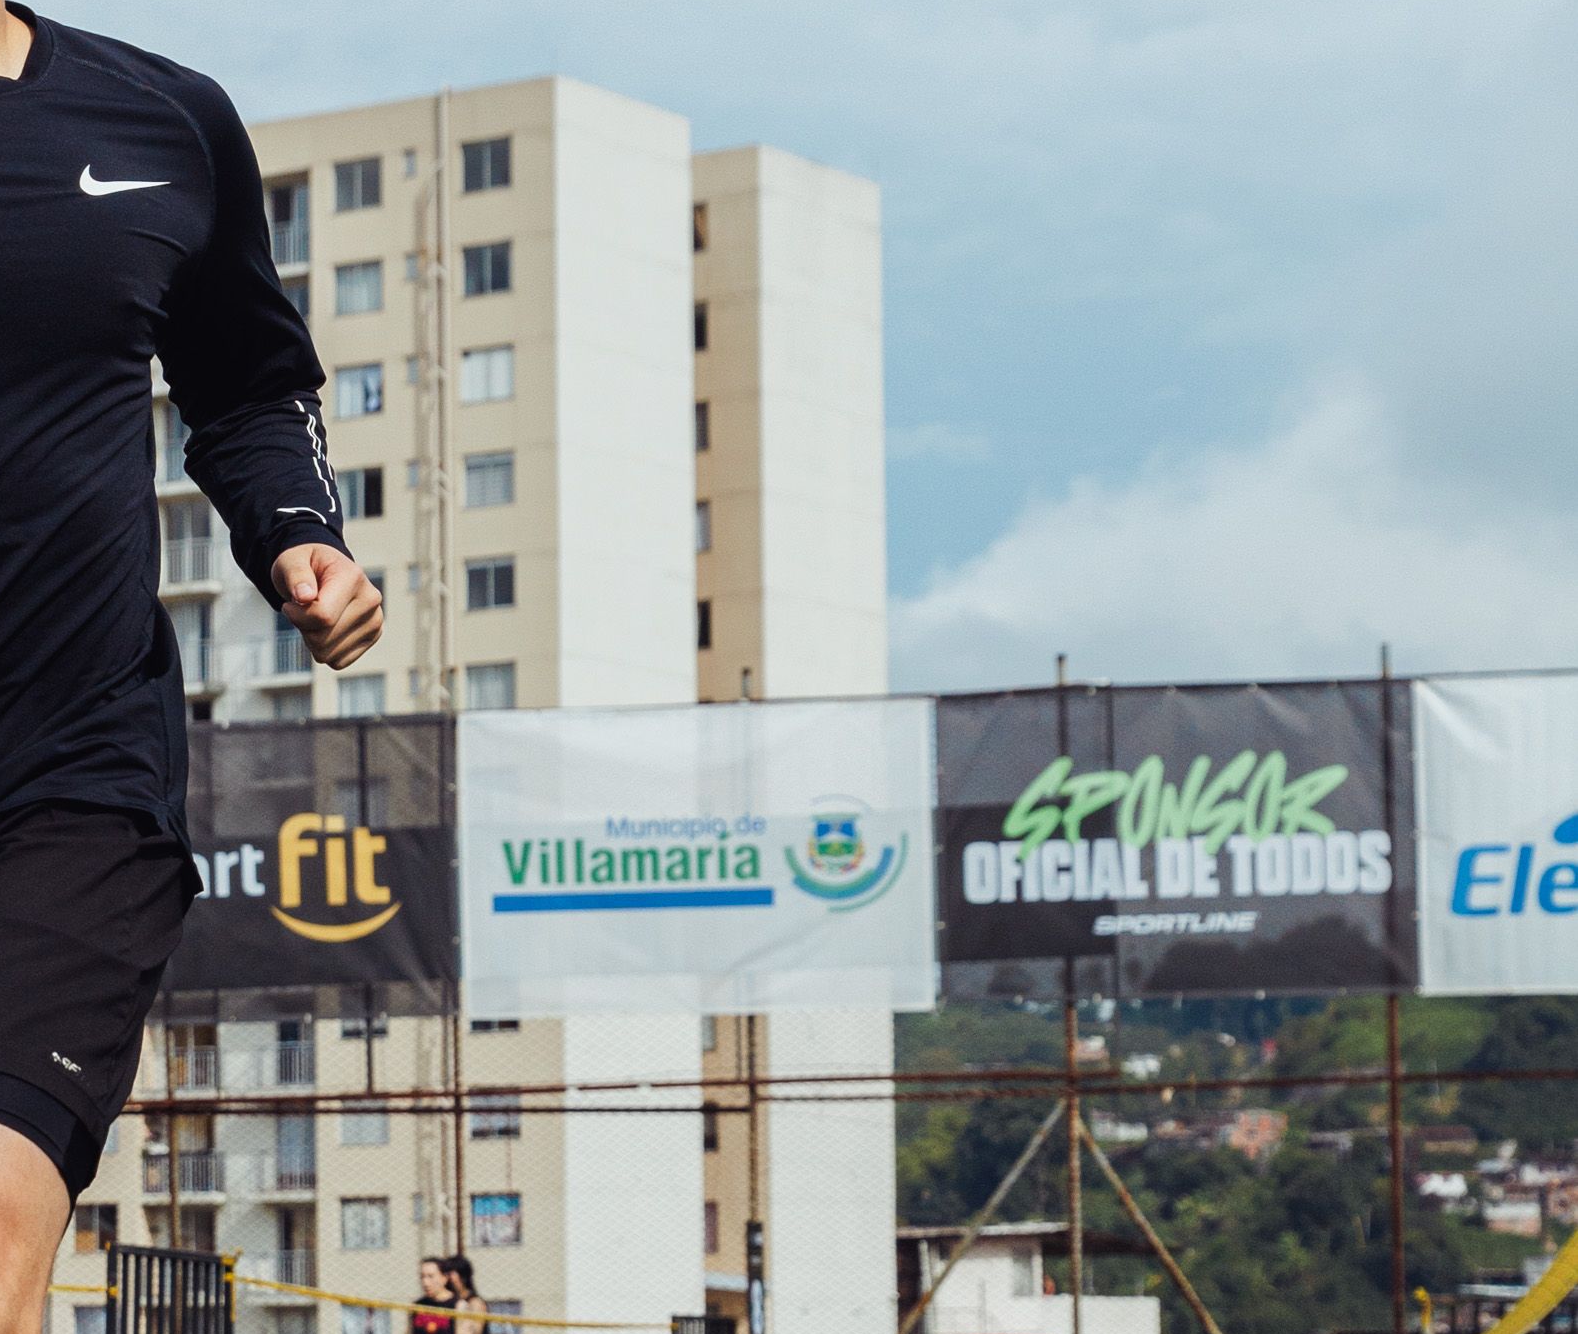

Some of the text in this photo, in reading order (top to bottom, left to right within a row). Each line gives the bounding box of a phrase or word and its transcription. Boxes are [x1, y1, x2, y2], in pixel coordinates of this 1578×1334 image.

[734, 813, 767, 836] de
[1001, 748, 1349, 861] SPONSOR
[278, 812, 390, 908] fit
[502, 831, 761, 884] Villamaría
[963, 830, 1392, 903] OFICIAL DE TODOS
